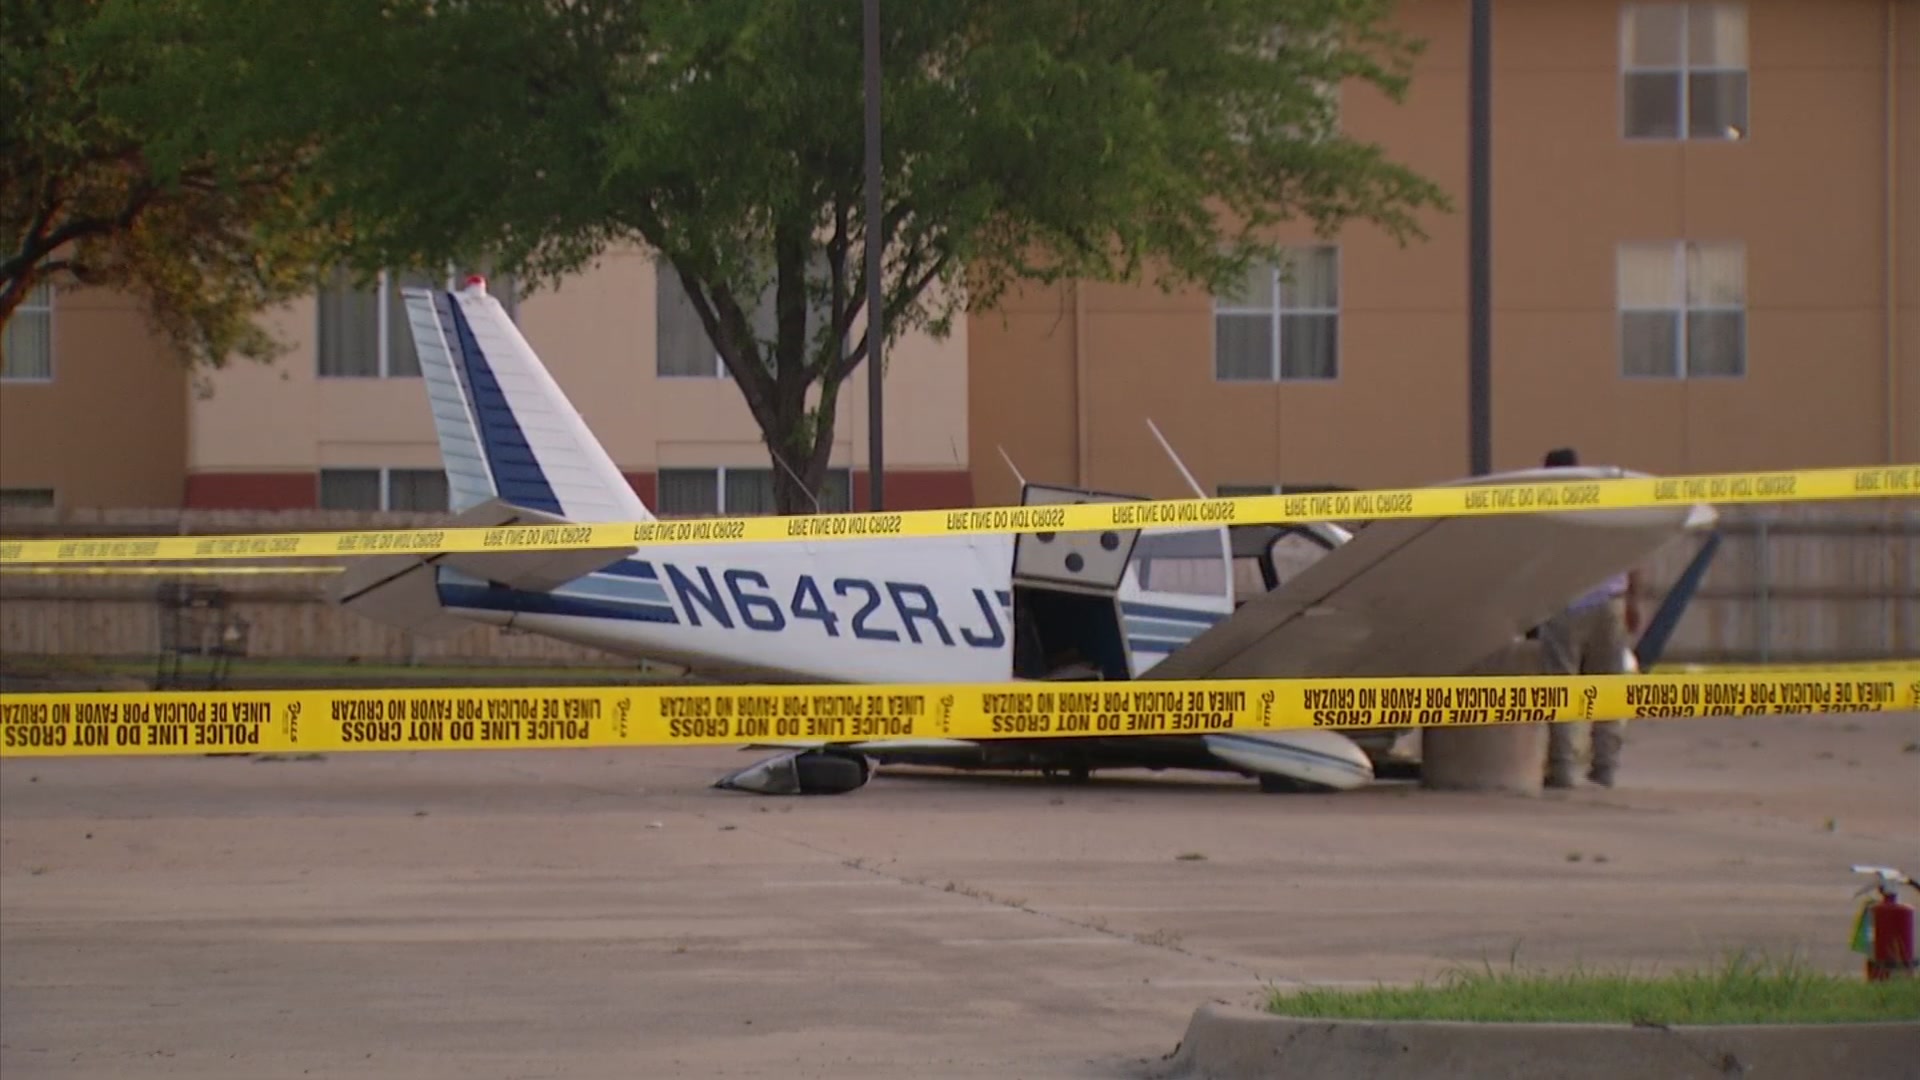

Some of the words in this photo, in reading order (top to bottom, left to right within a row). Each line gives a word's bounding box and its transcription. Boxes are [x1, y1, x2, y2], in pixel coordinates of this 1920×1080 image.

[1037, 692, 1055, 713] NO
[1058, 692, 1099, 713] FAVOR
[1103, 691, 1130, 712] POR
[1133, 691, 1184, 712] POLICIA
[1187, 690, 1204, 711] DE
[1208, 690, 1246, 711] LINEA
[1303, 689, 1355, 710] CRUZAR
[1359, 688, 1377, 709] NO
[1380, 688, 1422, 709] FAVOR
[1426, 687, 1452, 709] POR
[1455, 687, 1506, 708] POLICIA
[1510, 686, 1527, 708] DE
[1530, 686, 1569, 707] LINEA
[1626, 684, 1677, 706] CRUZAR
[1682, 683, 1700, 705] NO
[1704, 683, 1746, 705] FAVOR
[1750, 682, 1776, 704] POR
[1780, 682, 1832, 704] POLICIA
[1835, 681, 1851, 703] DE
[1856, 681, 1895, 703] LINEA
[52, 704, 71, 724] NO
[75, 703, 119, 724] FAVOR
[123, 703, 150, 723] POR
[153, 702, 207, 723] POLICIA
[210, 702, 229, 722] DE
[232, 701, 272, 722] LINEA
[331, 699, 384, 721] CRUZAR
[388, 699, 406, 720] NO
[410, 698, 451, 720] FAVOR
[457, 698, 483, 719] POR
[487, 697, 538, 719] POLICIA
[542, 697, 559, 718] DE
[563, 696, 602, 718] LINEA
[659, 696, 712, 717] CRUZAR
[715, 695, 732, 716] NO
[737, 695, 779, 716] FAVOR
[783, 694, 808, 716] POR
[812, 694, 863, 715] POLICIA
[867, 693, 883, 715] DE
[887, 693, 925, 714] LINEA
[982, 693, 1034, 714] CRUZAR
[851, 715, 914, 735] POLICE
[991, 715, 1050, 732] CROSS
[1055, 714, 1091, 731] NOT
[1096, 713, 1121, 731] DO
[1126, 713, 1166, 730] LINE
[1171, 712, 1234, 729] POLICE
[1312, 711, 1373, 726] CROSS
[1376, 710, 1413, 725] NOT
[1418, 710, 1443, 724] DO
[1448, 710, 1488, 724] LINE
[1493, 708, 1558, 722] POLICE
[4, 726, 68, 747] CROSS
[72, 725, 110, 746] NOT
[116, 724, 142, 746] DO
[147, 724, 190, 745] LINE
[194, 723, 261, 744] POLICE
[341, 721, 402, 742] CROSS
[407, 720, 444, 741] NOT
[450, 720, 475, 740] DO
[480, 719, 521, 740] LINE
[527, 718, 590, 739] POLICE
[669, 718, 729, 738] CROSS
[735, 717, 770, 737] NOT
[776, 717, 800, 736] DO
[806, 716, 846, 736] LINE
